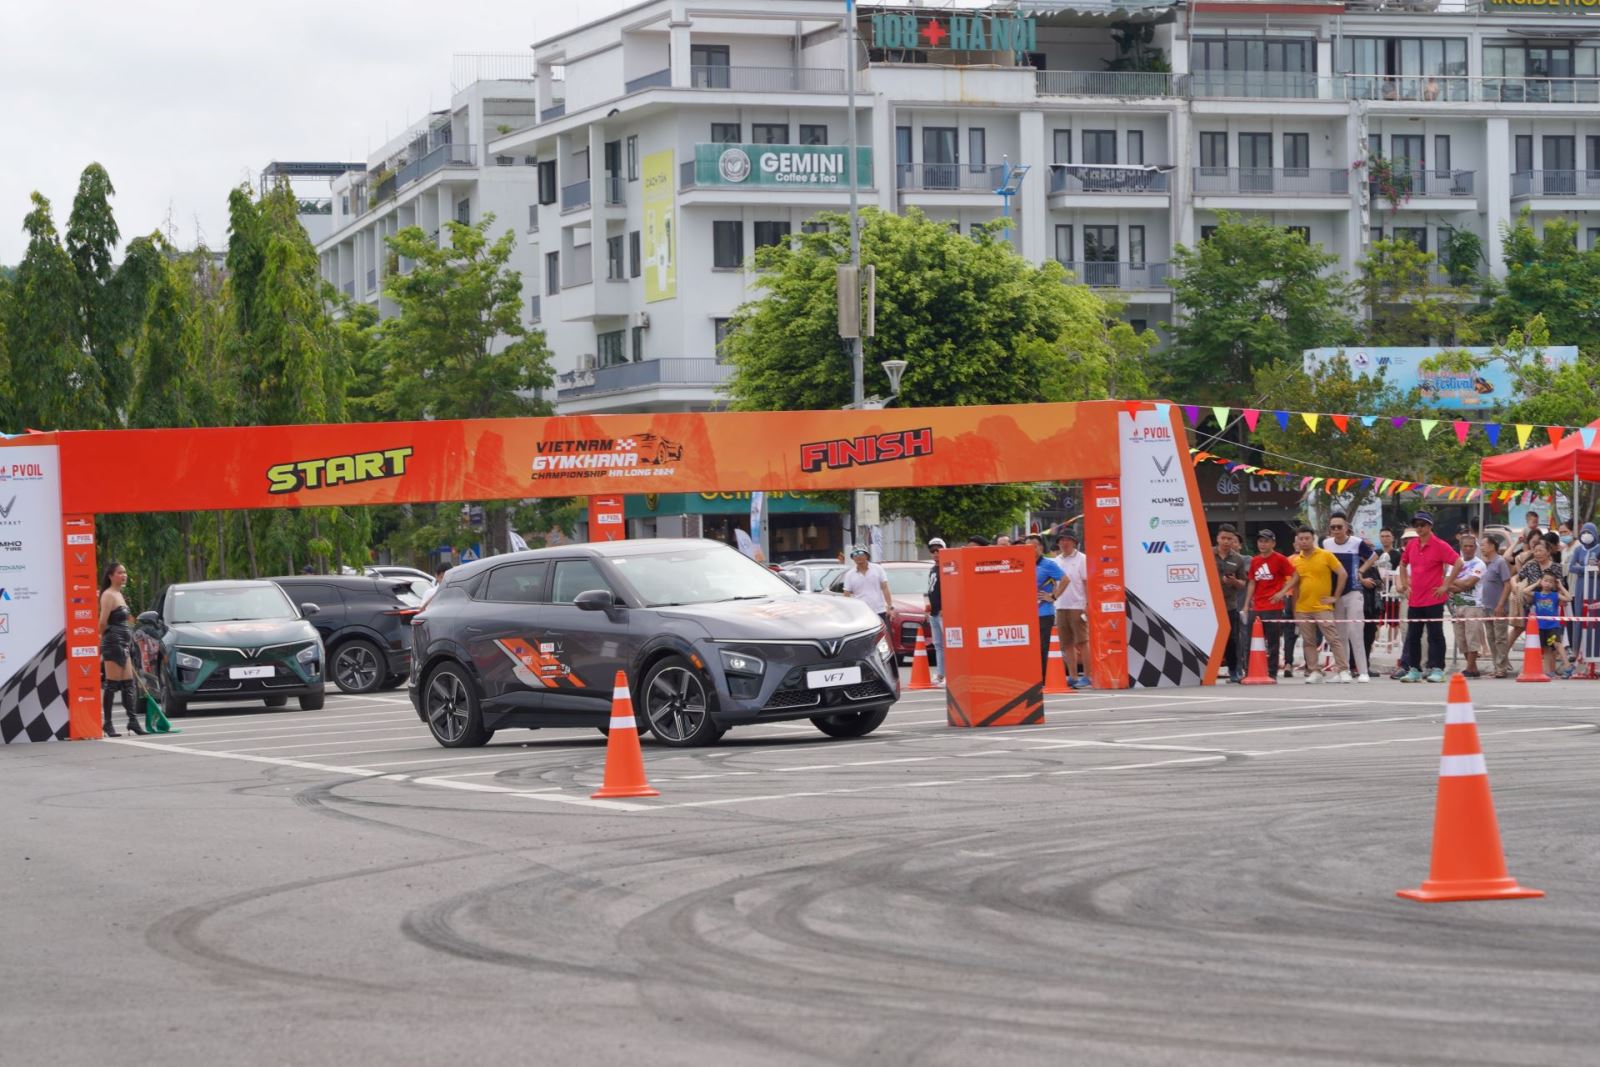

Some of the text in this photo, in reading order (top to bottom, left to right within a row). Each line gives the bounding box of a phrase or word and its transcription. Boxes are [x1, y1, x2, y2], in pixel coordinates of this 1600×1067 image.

[872, 13, 918, 49] 108
[760, 152, 843, 173] GEMINI
[775, 173, 836, 182] Coffee & Tea
[1143, 427, 1171, 439] PVOIL
[536, 439, 614, 453] VIETNAM
[801, 427, 933, 472] FINISH
[531, 453, 638, 470] GYMKHANA
[12, 463, 43, 477] PVOIL
[267, 447, 413, 494] START
[531, 470, 607, 480] CHAMPIONSHIP
[625, 468, 651, 477] LONG
[996, 626, 1026, 639] PVOIL
